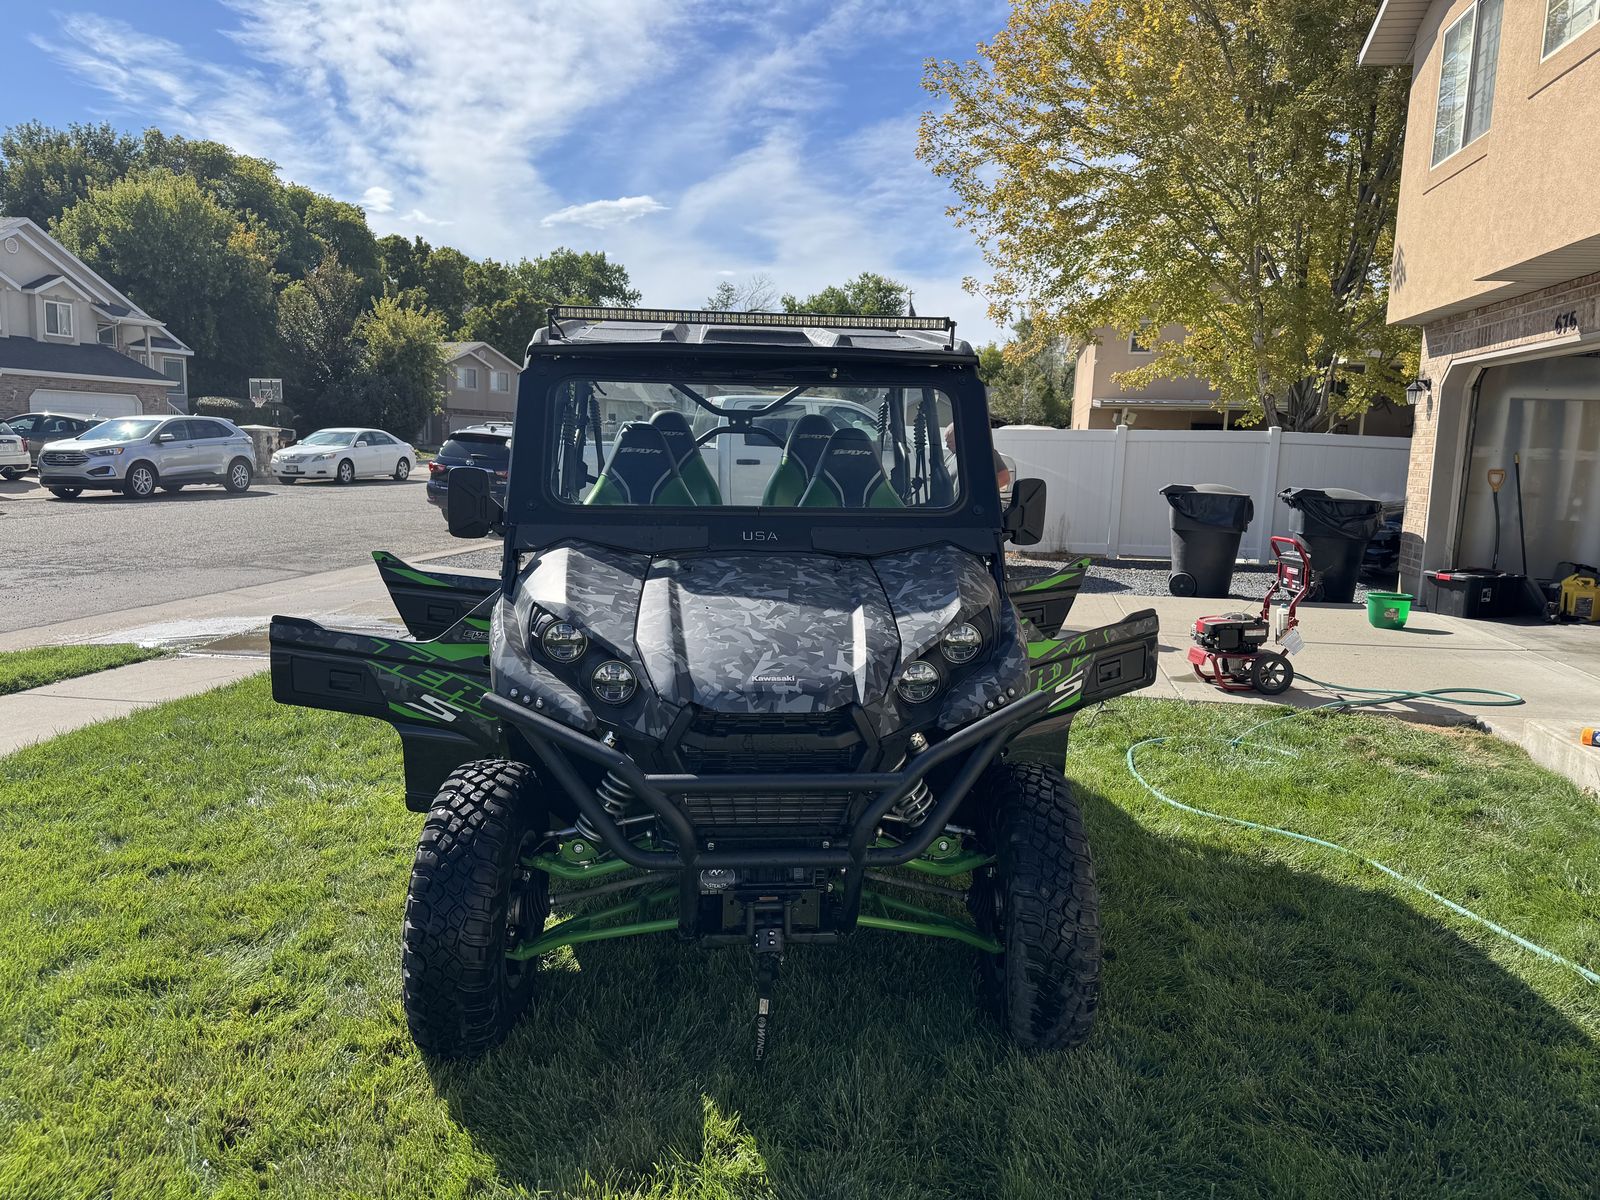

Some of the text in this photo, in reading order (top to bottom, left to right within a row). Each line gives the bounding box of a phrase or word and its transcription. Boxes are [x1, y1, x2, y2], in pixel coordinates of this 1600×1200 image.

[1555, 310, 1578, 335] 676
[742, 531, 778, 541] USA
[755, 1028, 766, 1061] WINCH
